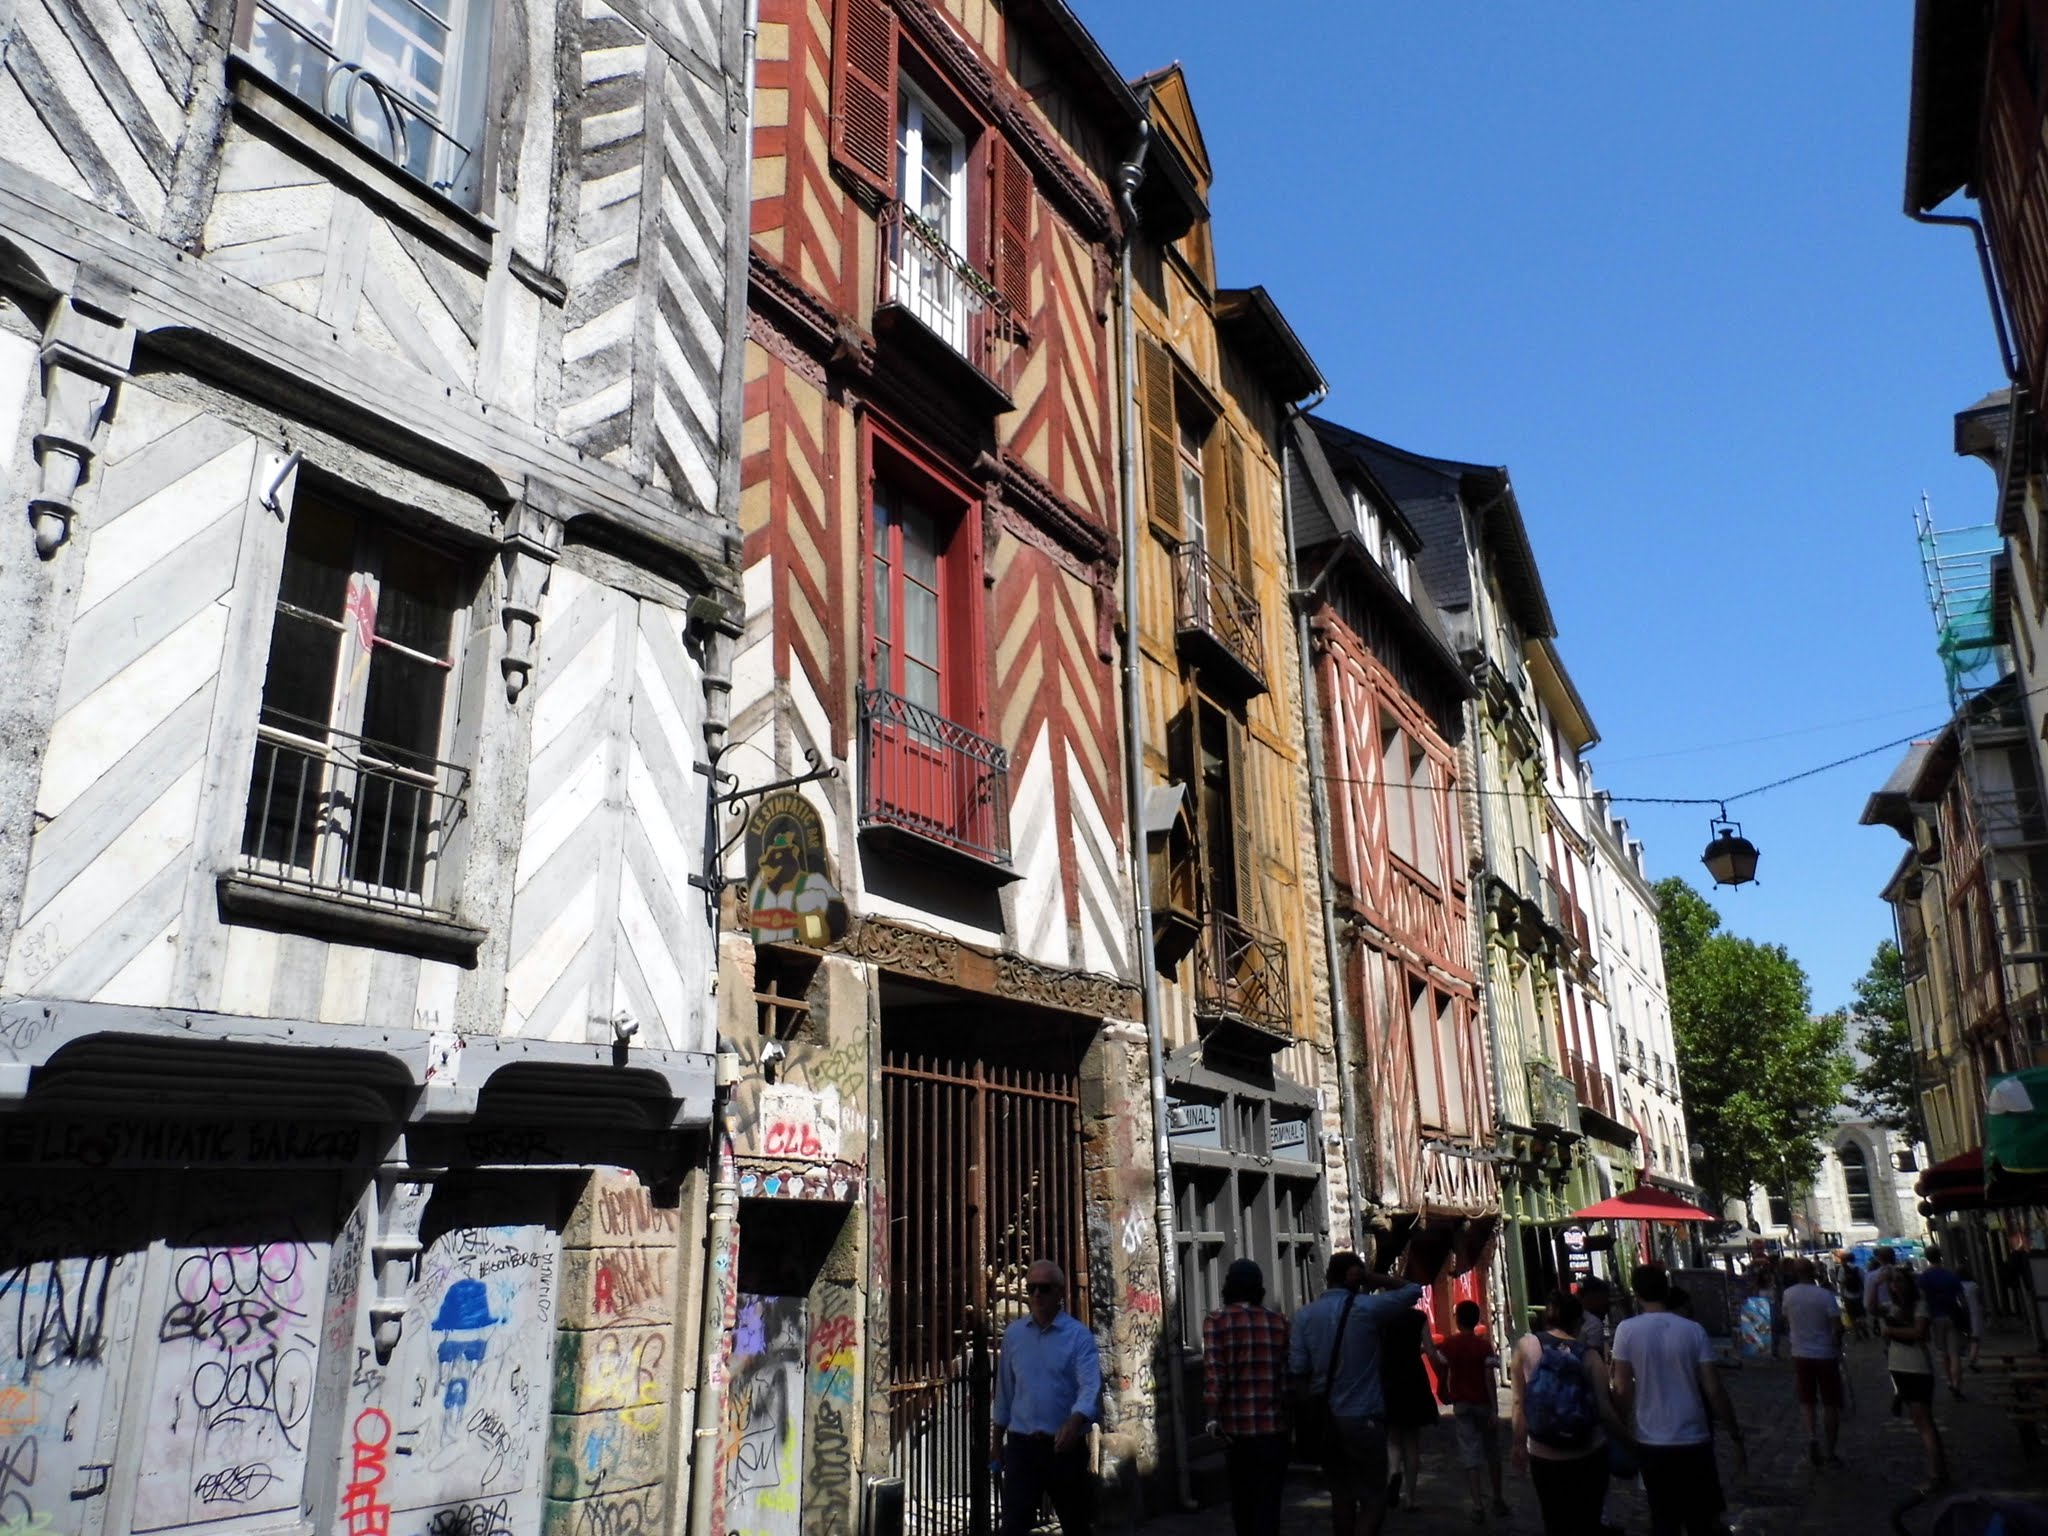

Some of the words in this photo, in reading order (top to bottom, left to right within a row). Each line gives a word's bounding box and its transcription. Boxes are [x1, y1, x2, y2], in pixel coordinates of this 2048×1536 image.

[751, 815, 766, 835] LE
[762, 796, 815, 826] SYMPATIC
[807, 828, 820, 848] BAR
[1211, 1105, 1216, 1124] 5
[1270, 1124, 1299, 1143] ERMINAL
[1300, 1122, 1305, 1138] 5
